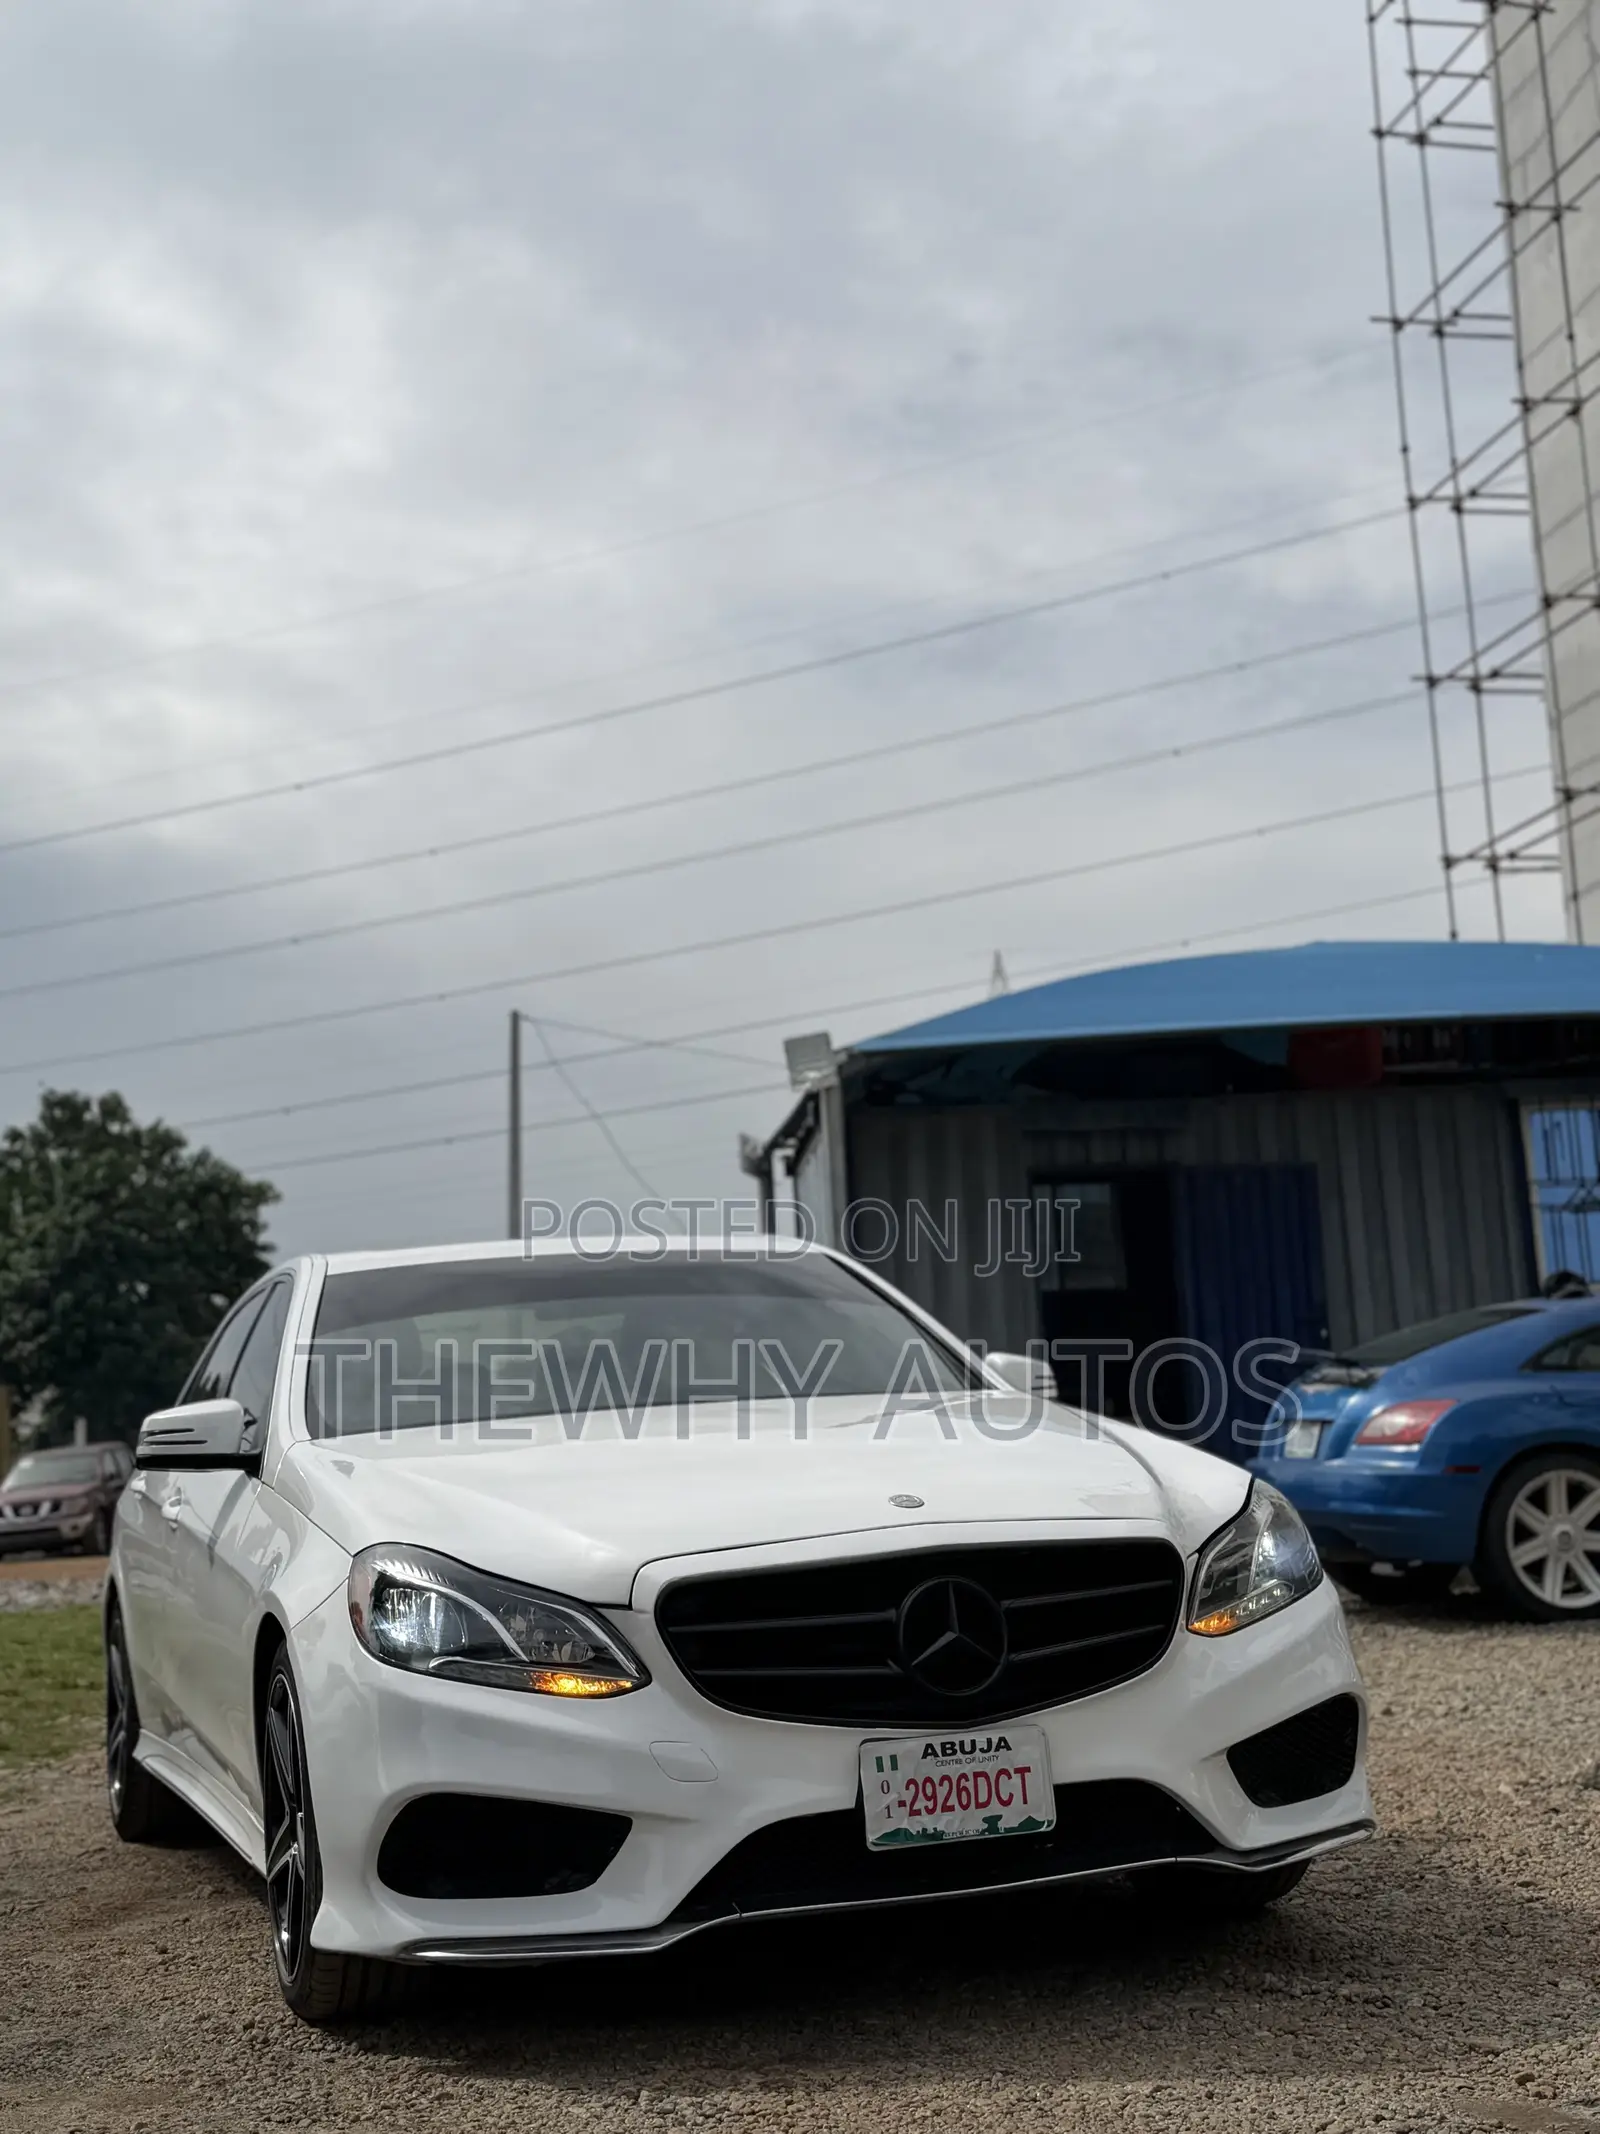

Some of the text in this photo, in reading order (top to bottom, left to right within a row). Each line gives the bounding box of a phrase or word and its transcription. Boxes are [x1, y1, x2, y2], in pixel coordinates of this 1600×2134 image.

[921, 1736, 1012, 1759] ABUJA
[935, 1759, 963, 1767] CENTRE
[978, 1755, 999, 1763] UNITY
